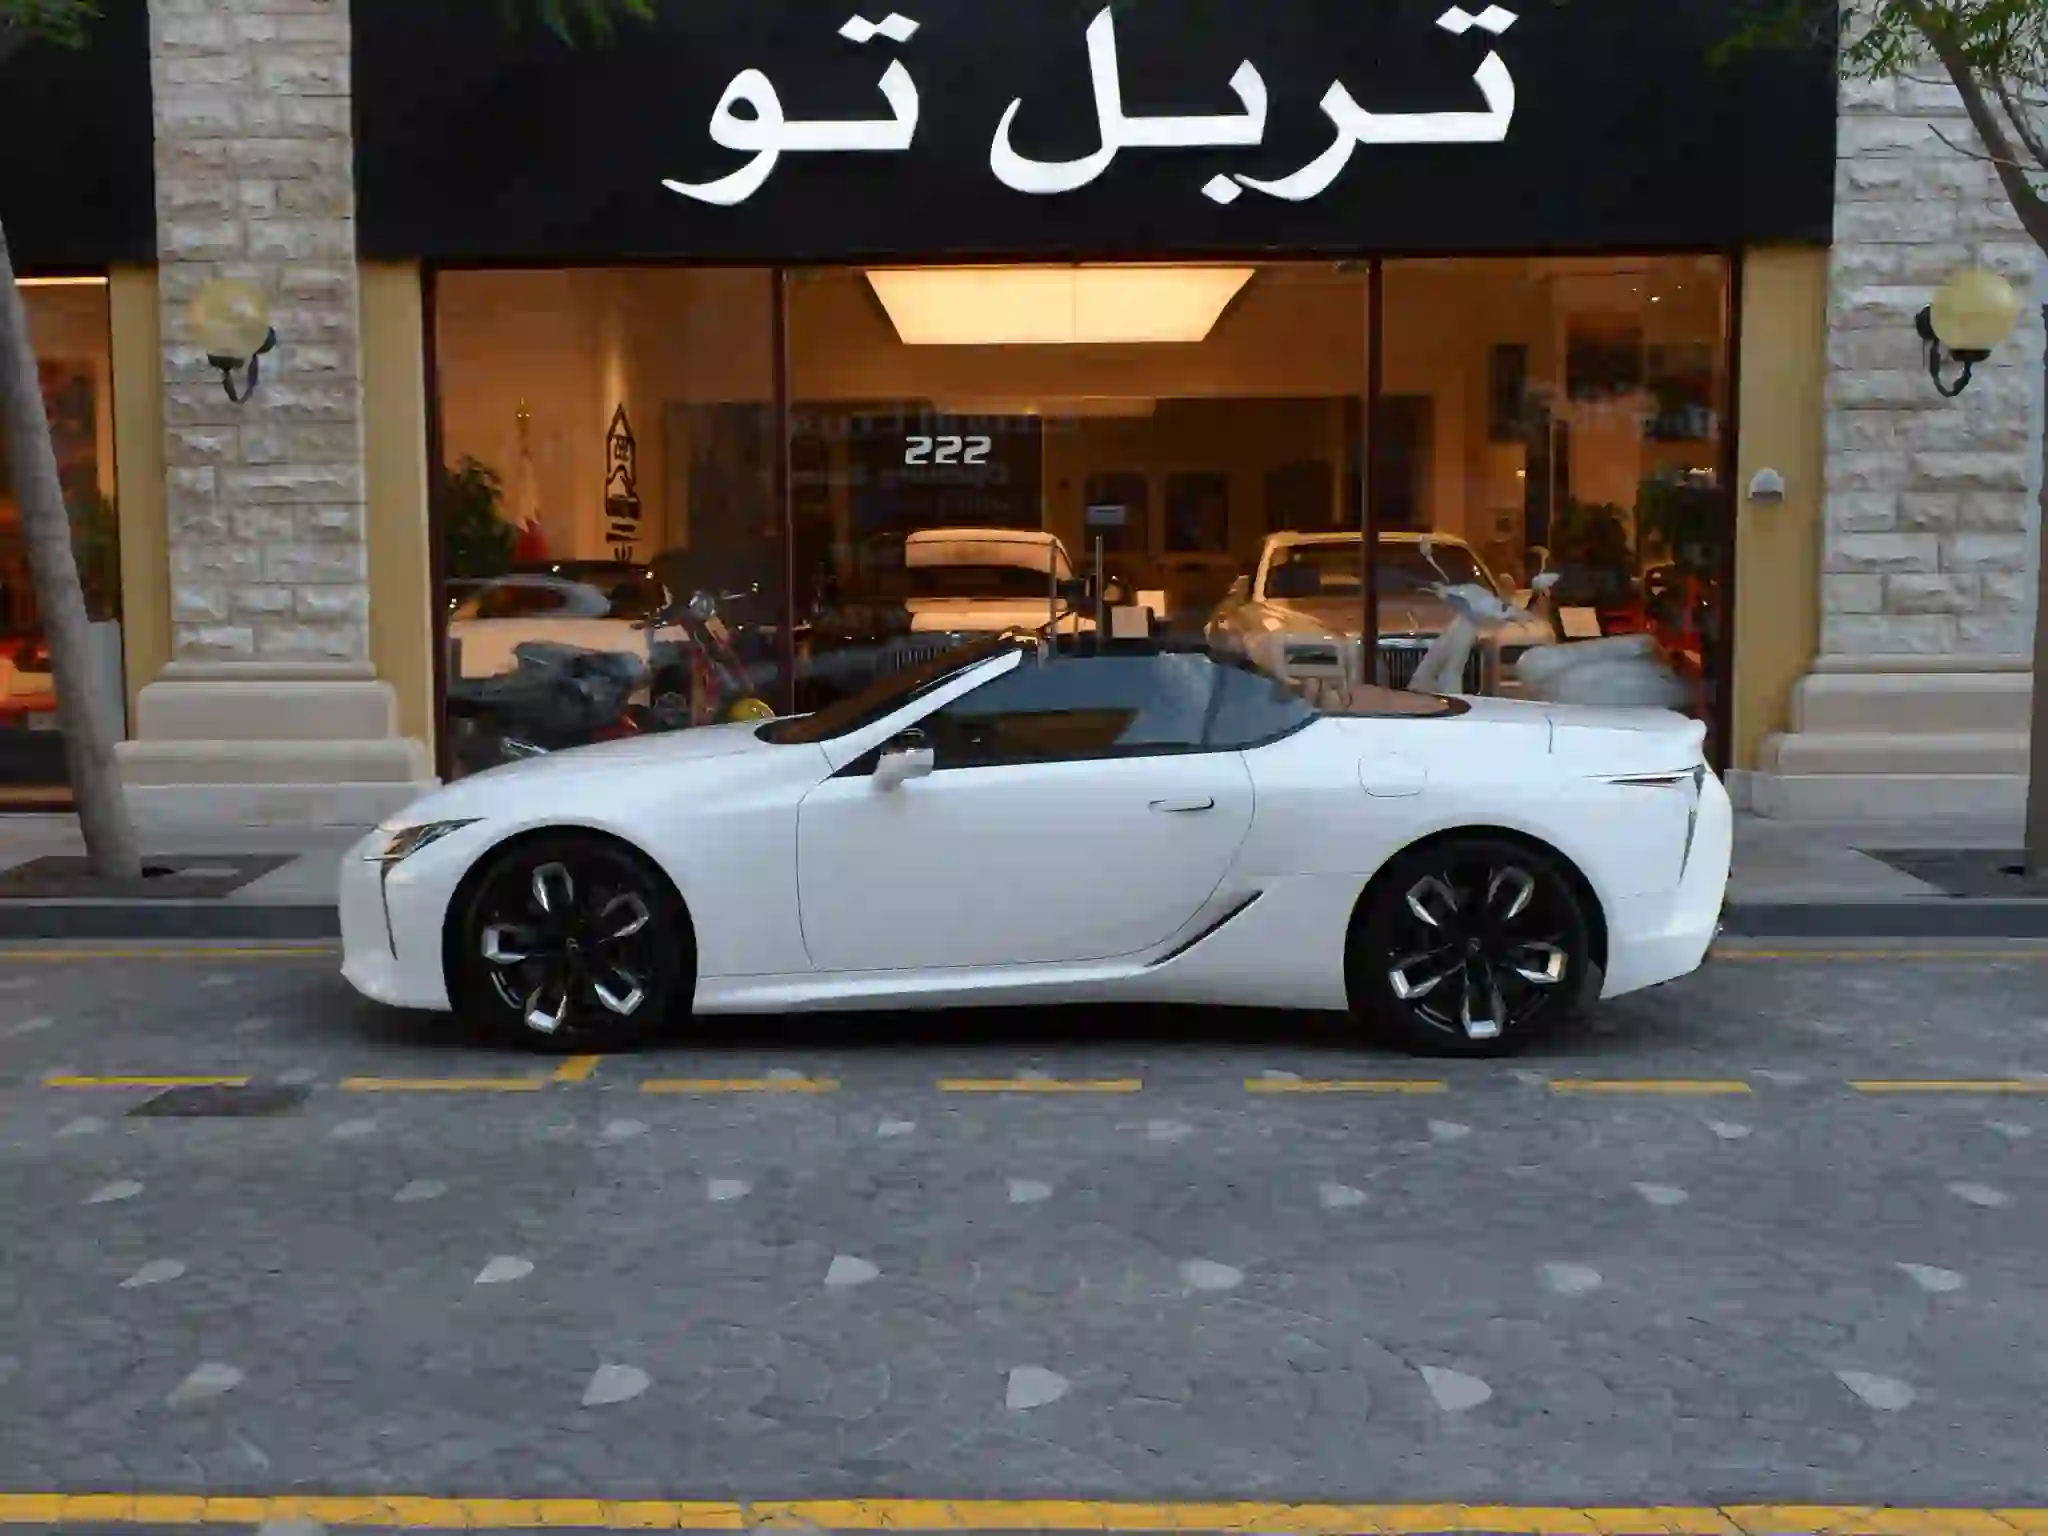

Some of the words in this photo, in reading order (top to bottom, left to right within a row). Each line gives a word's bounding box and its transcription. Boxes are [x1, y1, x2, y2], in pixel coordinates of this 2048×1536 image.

[662, 12, 920, 206] تو
[990, 4, 1518, 205] تربل
[904, 435, 992, 465] 222
